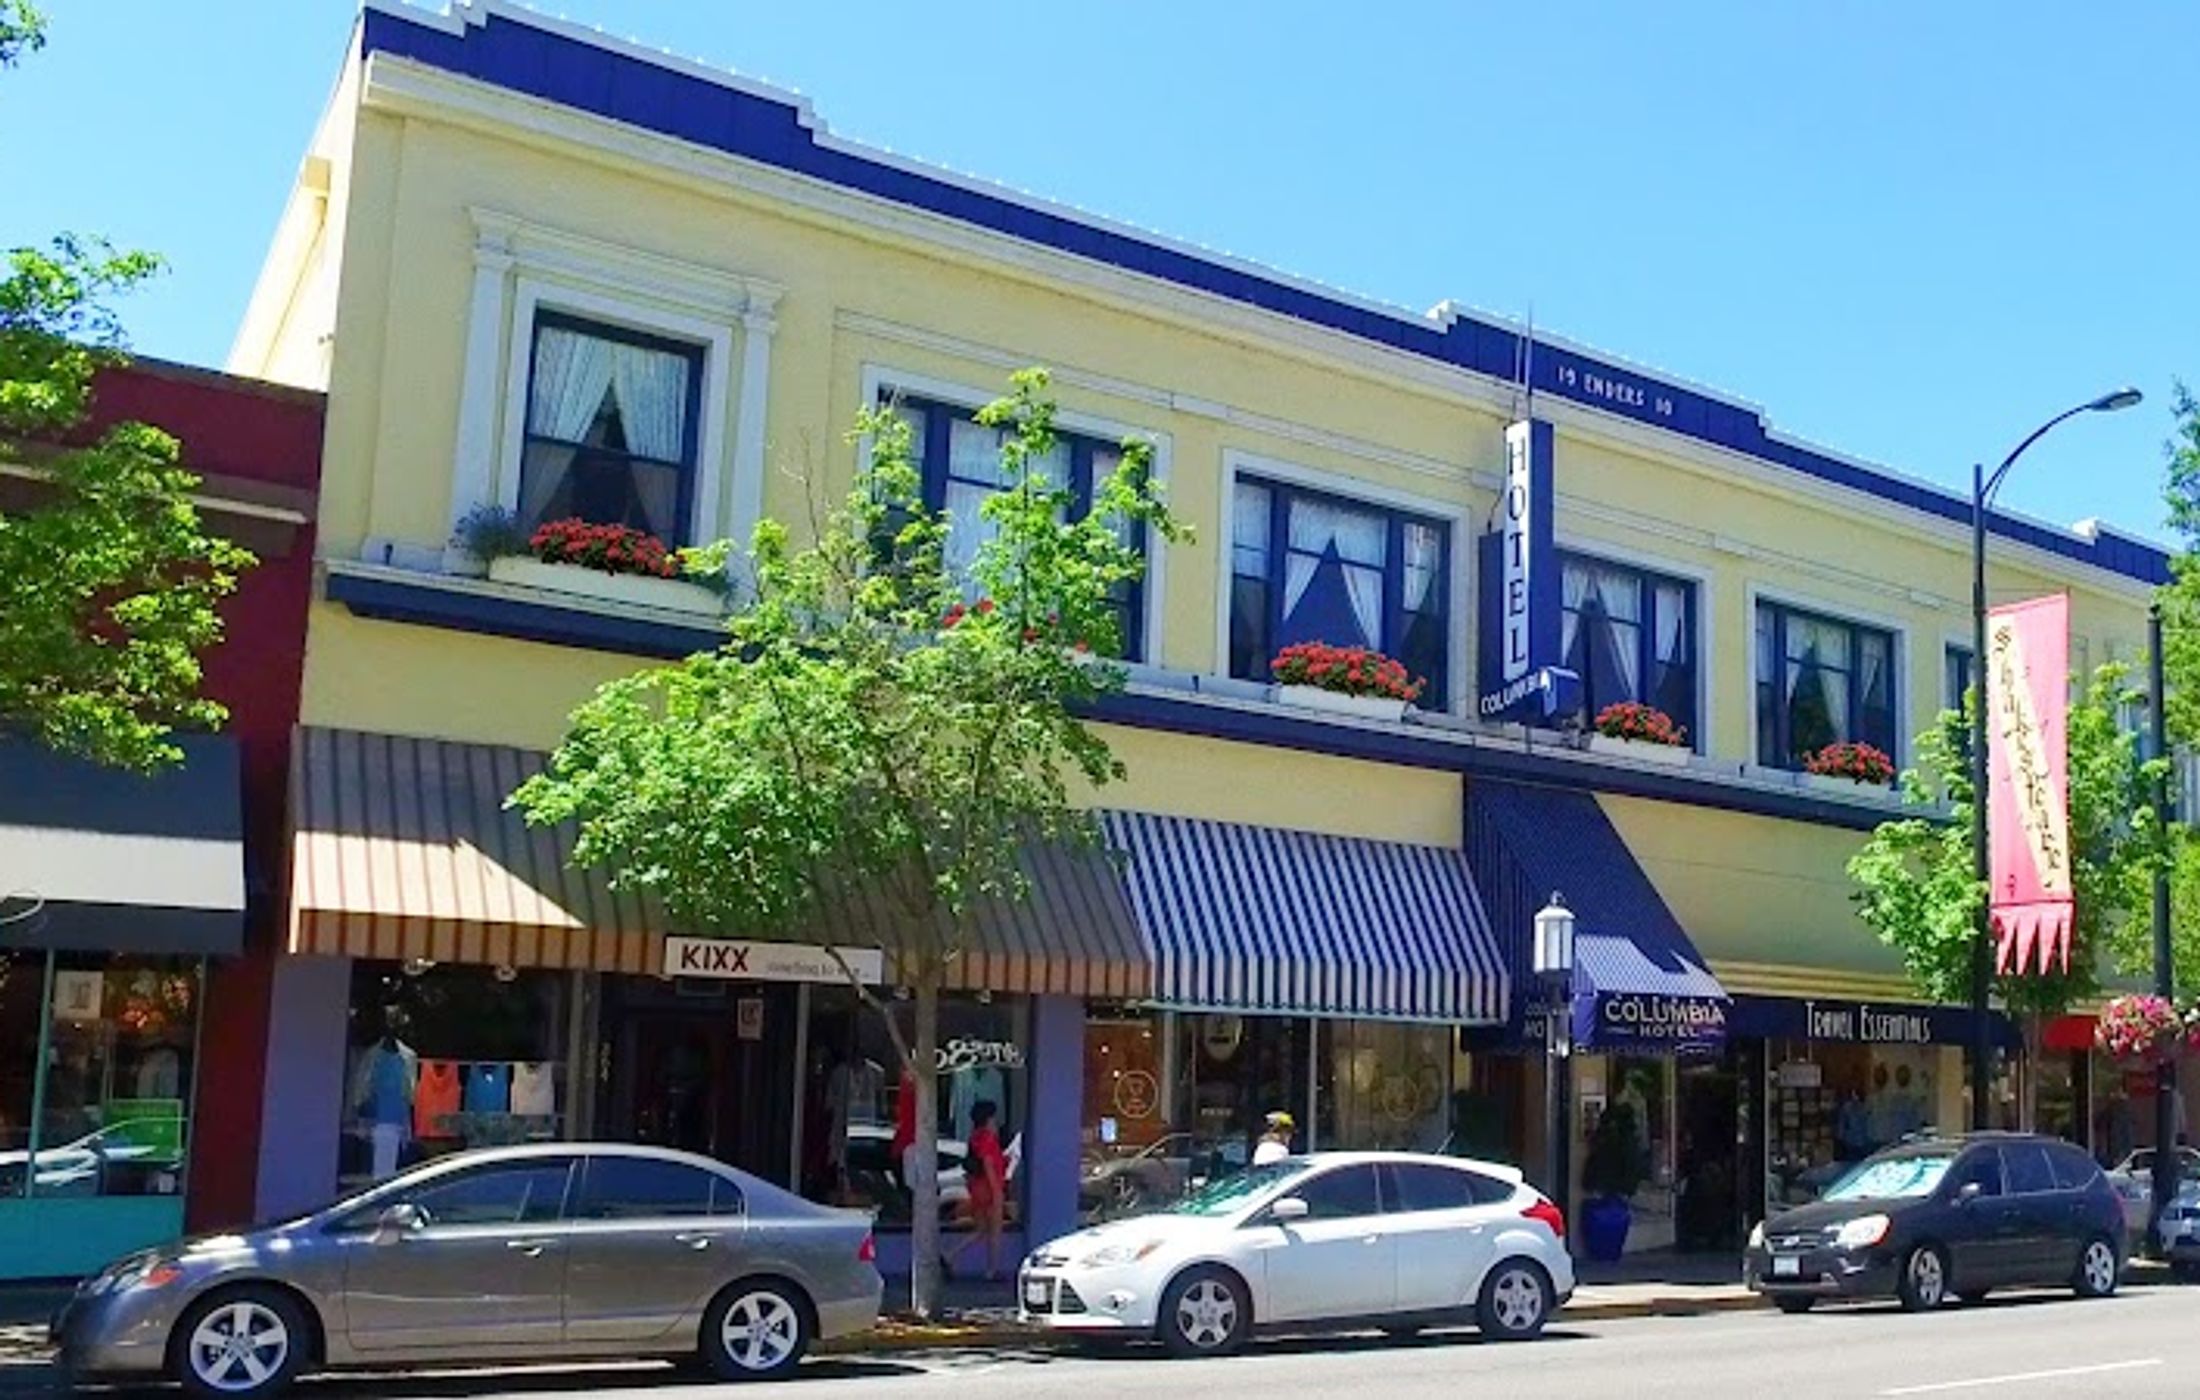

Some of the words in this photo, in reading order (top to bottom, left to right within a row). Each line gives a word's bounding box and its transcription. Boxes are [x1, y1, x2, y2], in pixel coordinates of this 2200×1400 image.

[1558, 365, 1576, 387] 19
[1584, 373, 1645, 406] ENDERS
[1508, 436, 1526, 664] HOTEL
[1481, 669, 1541, 715] COLUMBI
[681, 945, 749, 973] KIXX
[1605, 1001, 1726, 1024] COLUMBIA
[1640, 1025, 1700, 1037] HOTEL
